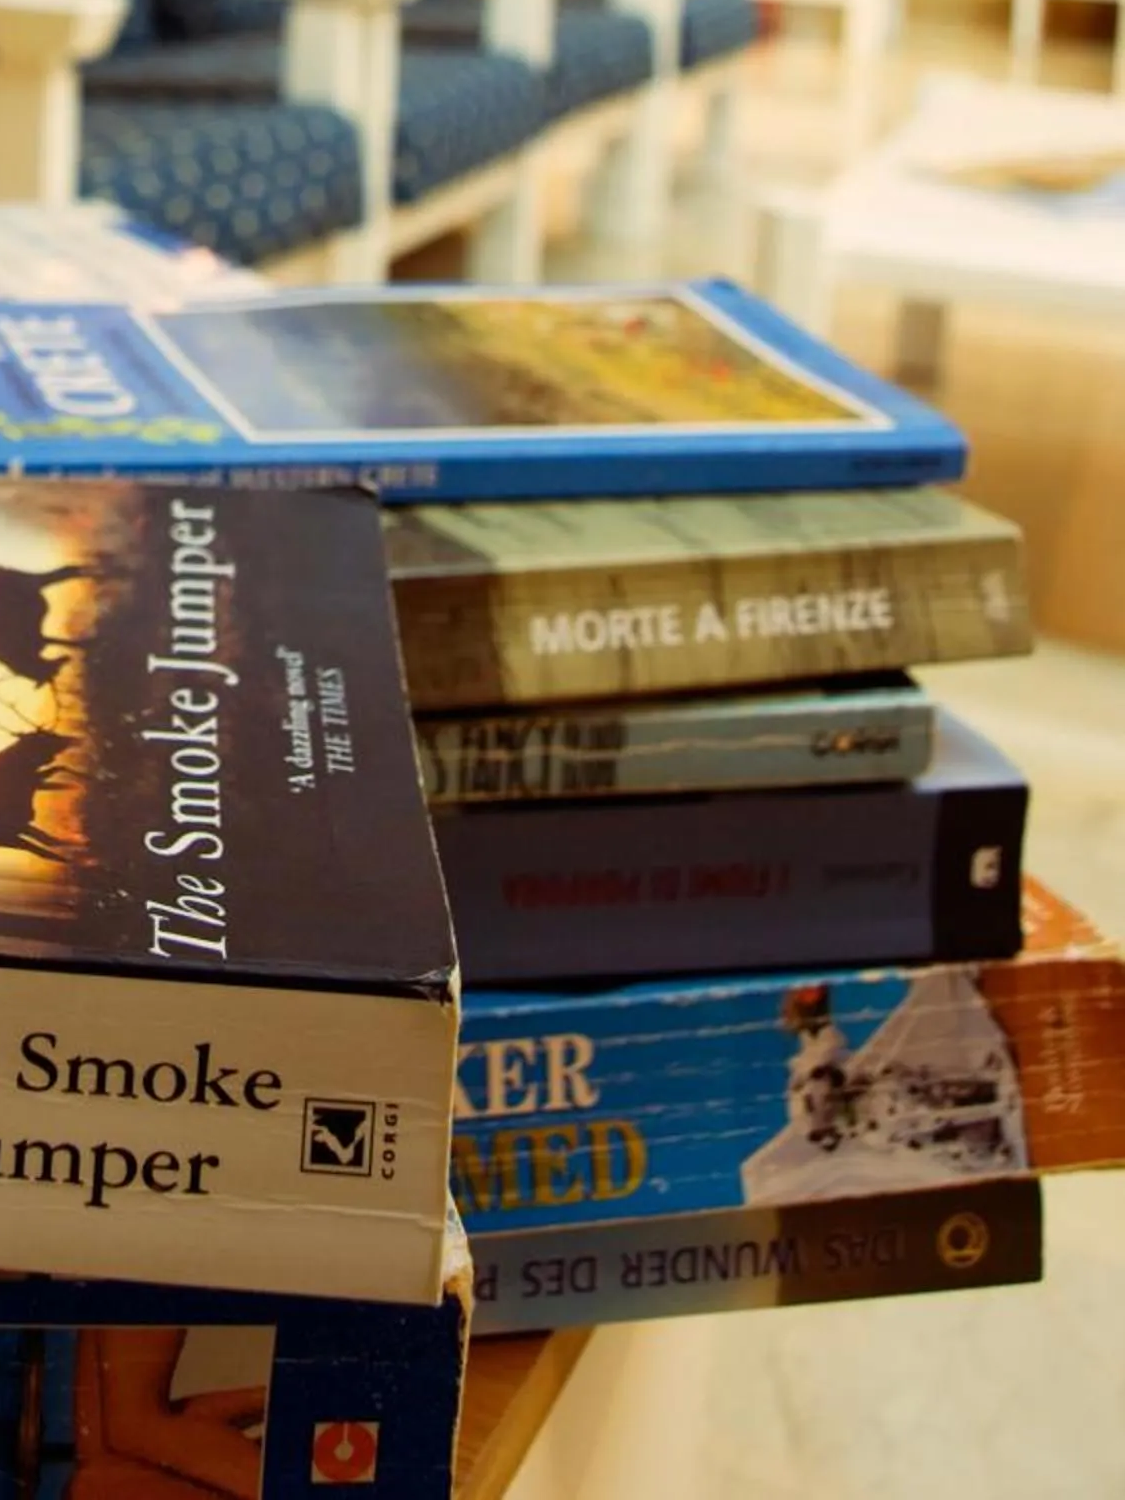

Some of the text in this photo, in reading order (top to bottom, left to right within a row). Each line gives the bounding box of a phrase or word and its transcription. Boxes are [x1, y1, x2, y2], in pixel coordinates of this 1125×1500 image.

[529, 587, 894, 653] MORTE A FIRENZE
[141, 499, 239, 961] The Smoke Jumper
[281, 699, 316, 769] dazzling
[315, 666, 355, 774] THE TIMES
[15, 1031, 283, 1111] Smoke
[381, 1102, 400, 1180] CORGI
[519, 1255, 598, 1299] DES
[621, 1238, 803, 1290] WUNDER
[824, 1225, 906, 1273] DAS
